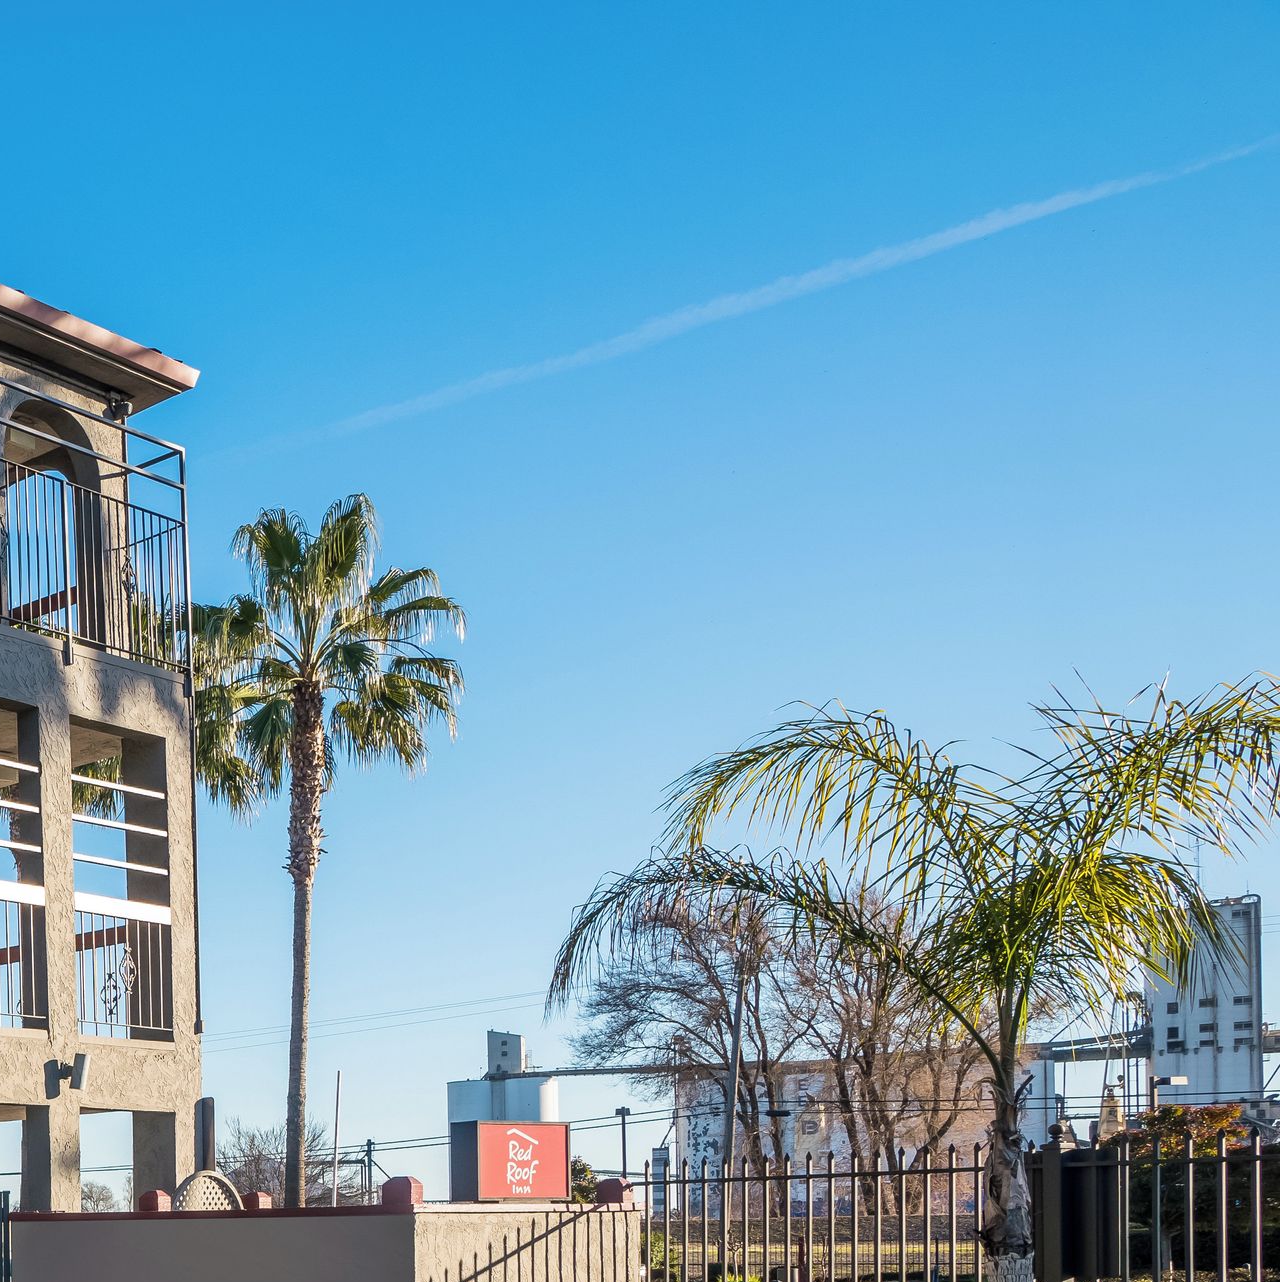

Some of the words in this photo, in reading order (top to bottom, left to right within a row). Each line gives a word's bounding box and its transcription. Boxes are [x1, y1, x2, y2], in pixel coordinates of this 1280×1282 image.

[509, 1140, 533, 1161] Red
[506, 1160, 539, 1184] Roof
[512, 1185, 532, 1194] Inn
